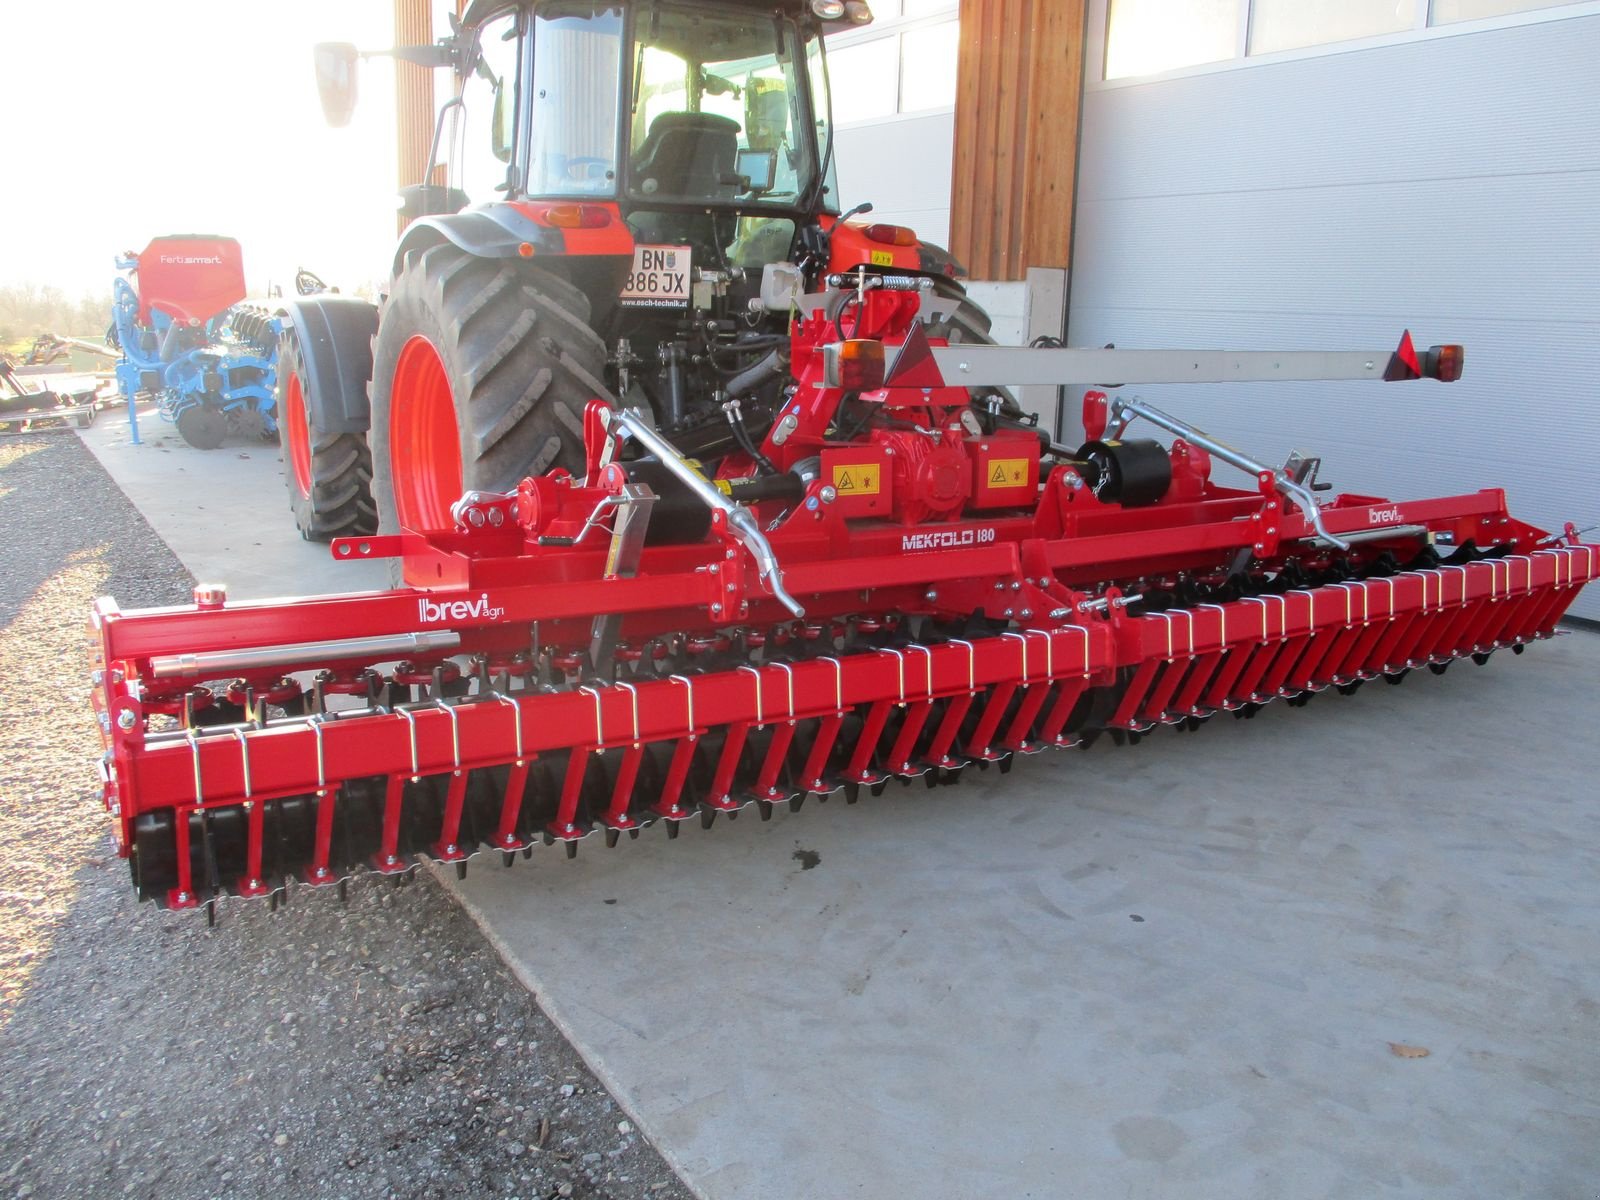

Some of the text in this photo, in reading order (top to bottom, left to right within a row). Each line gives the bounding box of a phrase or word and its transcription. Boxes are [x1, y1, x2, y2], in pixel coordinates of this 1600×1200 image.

[642, 249, 664, 271] BN
[625, 271, 684, 294] 886 JX
[1369, 505, 1397, 524] brevi
[977, 527, 995, 543] 180
[418, 593, 504, 623] brevi agri
